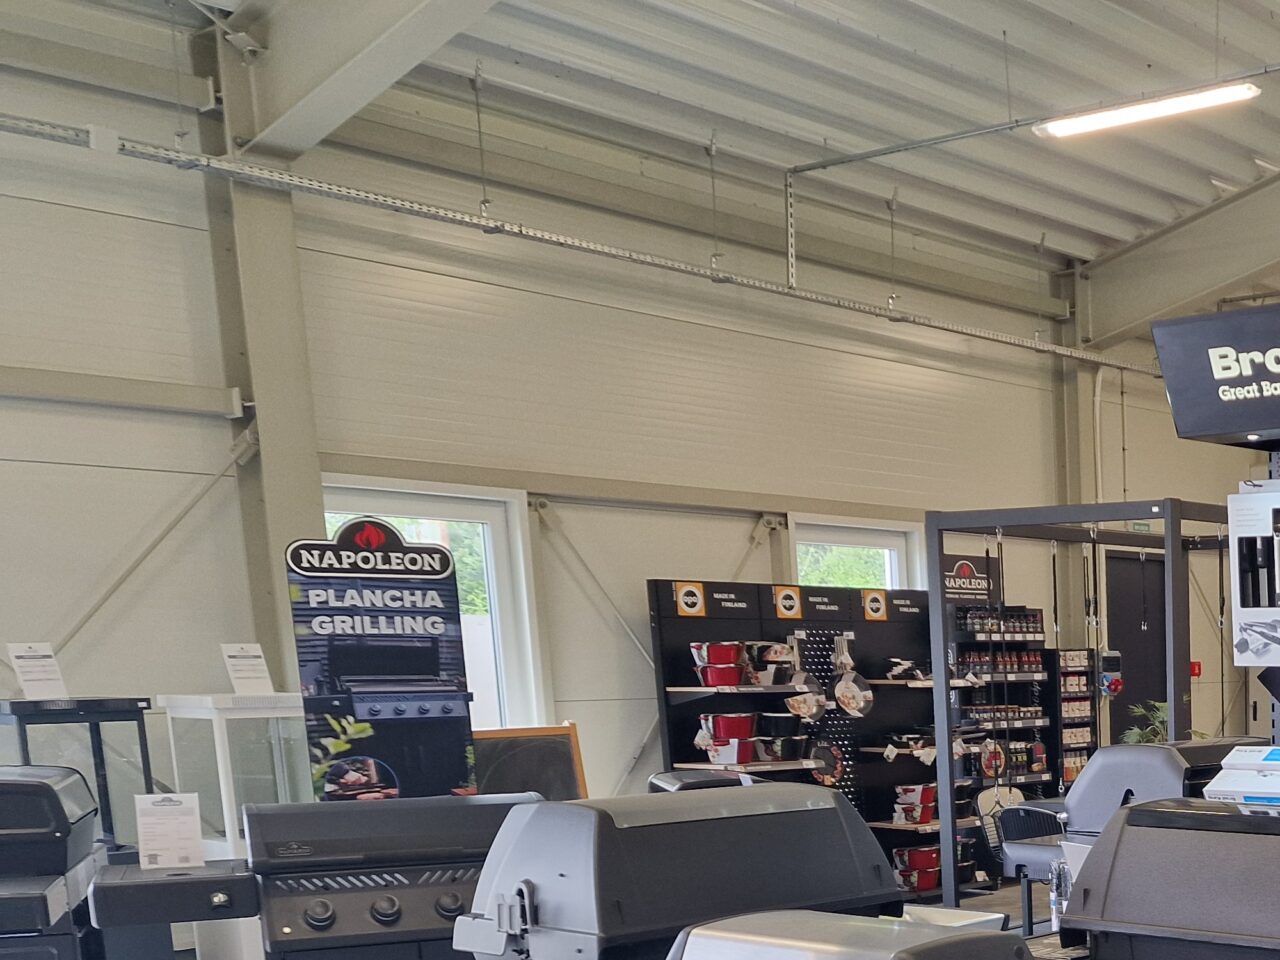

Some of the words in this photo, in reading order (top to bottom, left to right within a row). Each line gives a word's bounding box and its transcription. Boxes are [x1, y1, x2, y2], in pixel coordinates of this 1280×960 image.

[1218, 385, 1260, 401] Great
[299, 550, 442, 571] NAPOLEON
[308, 589, 445, 608] PLANCHA
[311, 615, 446, 635] GRILLING
